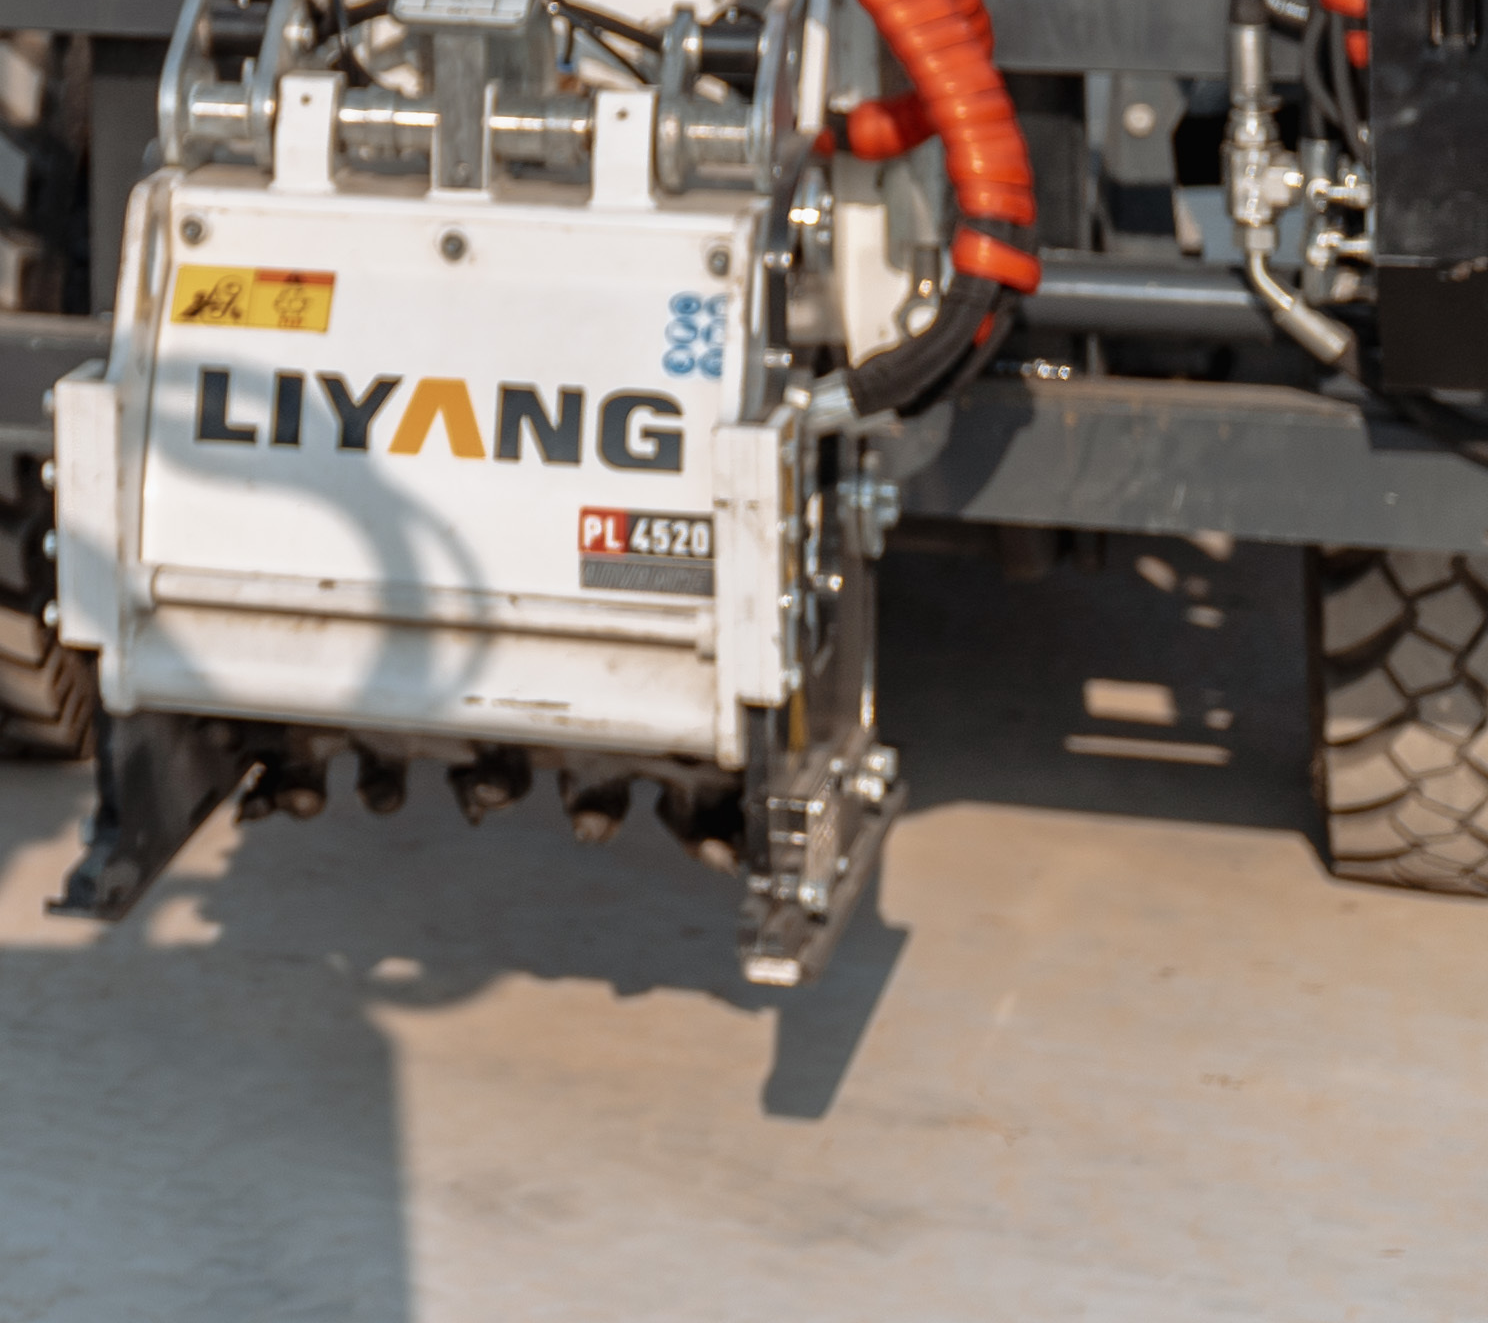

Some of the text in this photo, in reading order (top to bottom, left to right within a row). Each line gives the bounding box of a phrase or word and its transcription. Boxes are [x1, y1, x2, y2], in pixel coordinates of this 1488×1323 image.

[196, 369, 683, 473] LIYANG
[583, 514, 711, 557] PL 4520
